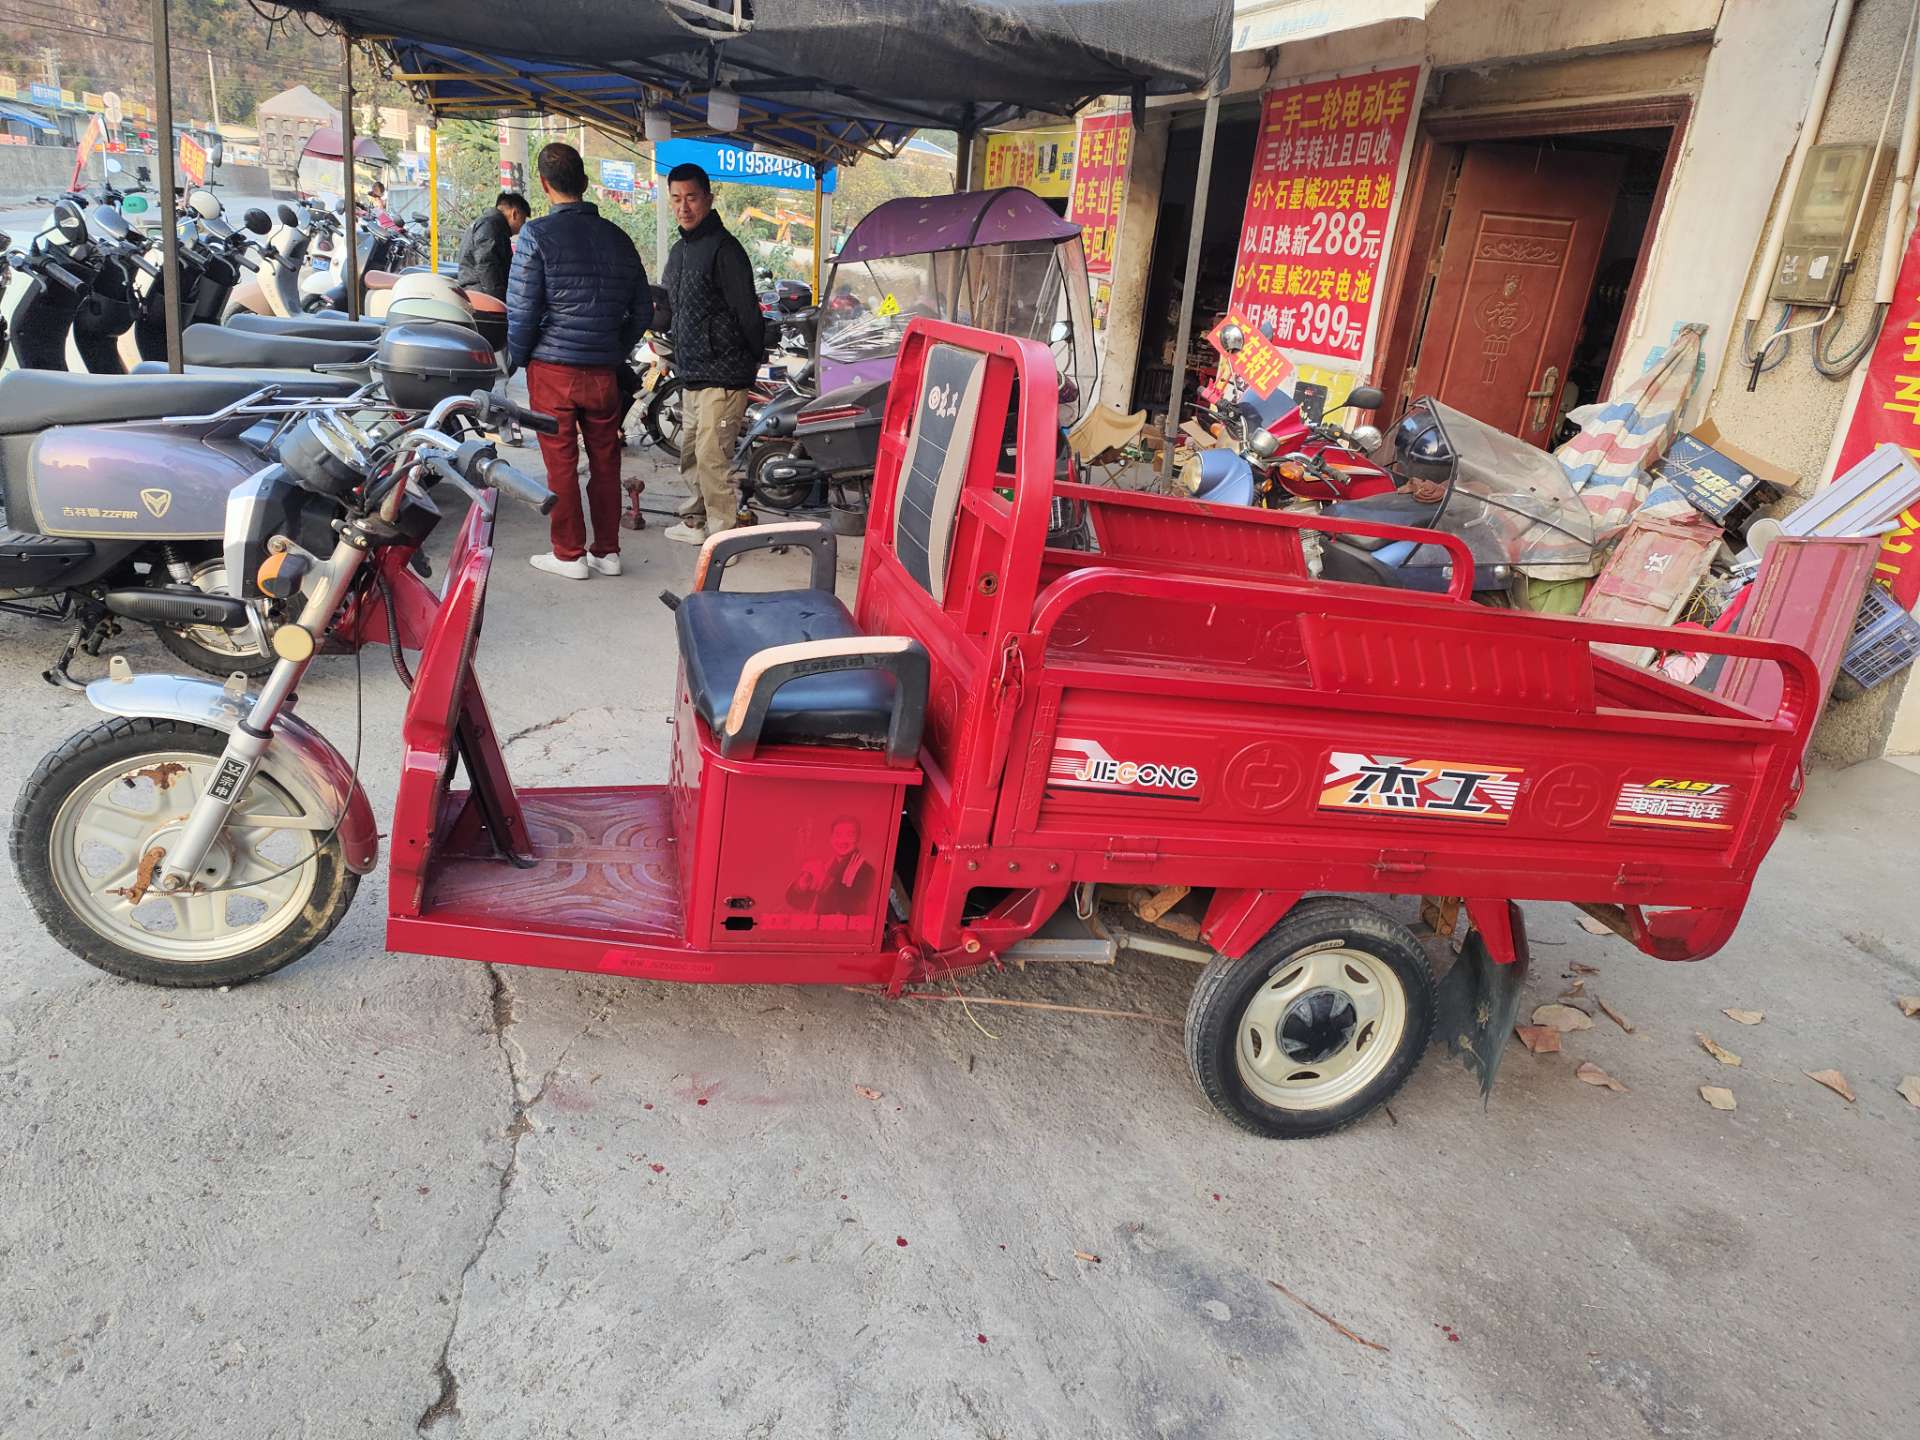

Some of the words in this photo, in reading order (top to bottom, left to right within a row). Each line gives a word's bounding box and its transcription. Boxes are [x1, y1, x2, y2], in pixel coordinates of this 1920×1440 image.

[1264, 78, 1411, 137] 二手二轮电动车
[1080, 127, 1132, 169] 电车出租
[1073, 176, 1125, 216] 电车出售
[1252, 172, 1393, 210] 5个石墨烯22安电池
[1243, 211, 1382, 260] 以旧换新288元
[1236, 261, 1373, 304] 6个石墨烯22安电池
[1216, 315, 1285, 391] 二车转让
[215, 775, 236, 796] 宗申
[1075, 758, 1198, 790] JIEGONG
[1344, 763, 1509, 815] 杰工
[1643, 778, 1733, 796] FAST
[1631, 797, 1725, 820] 电动三轮车
